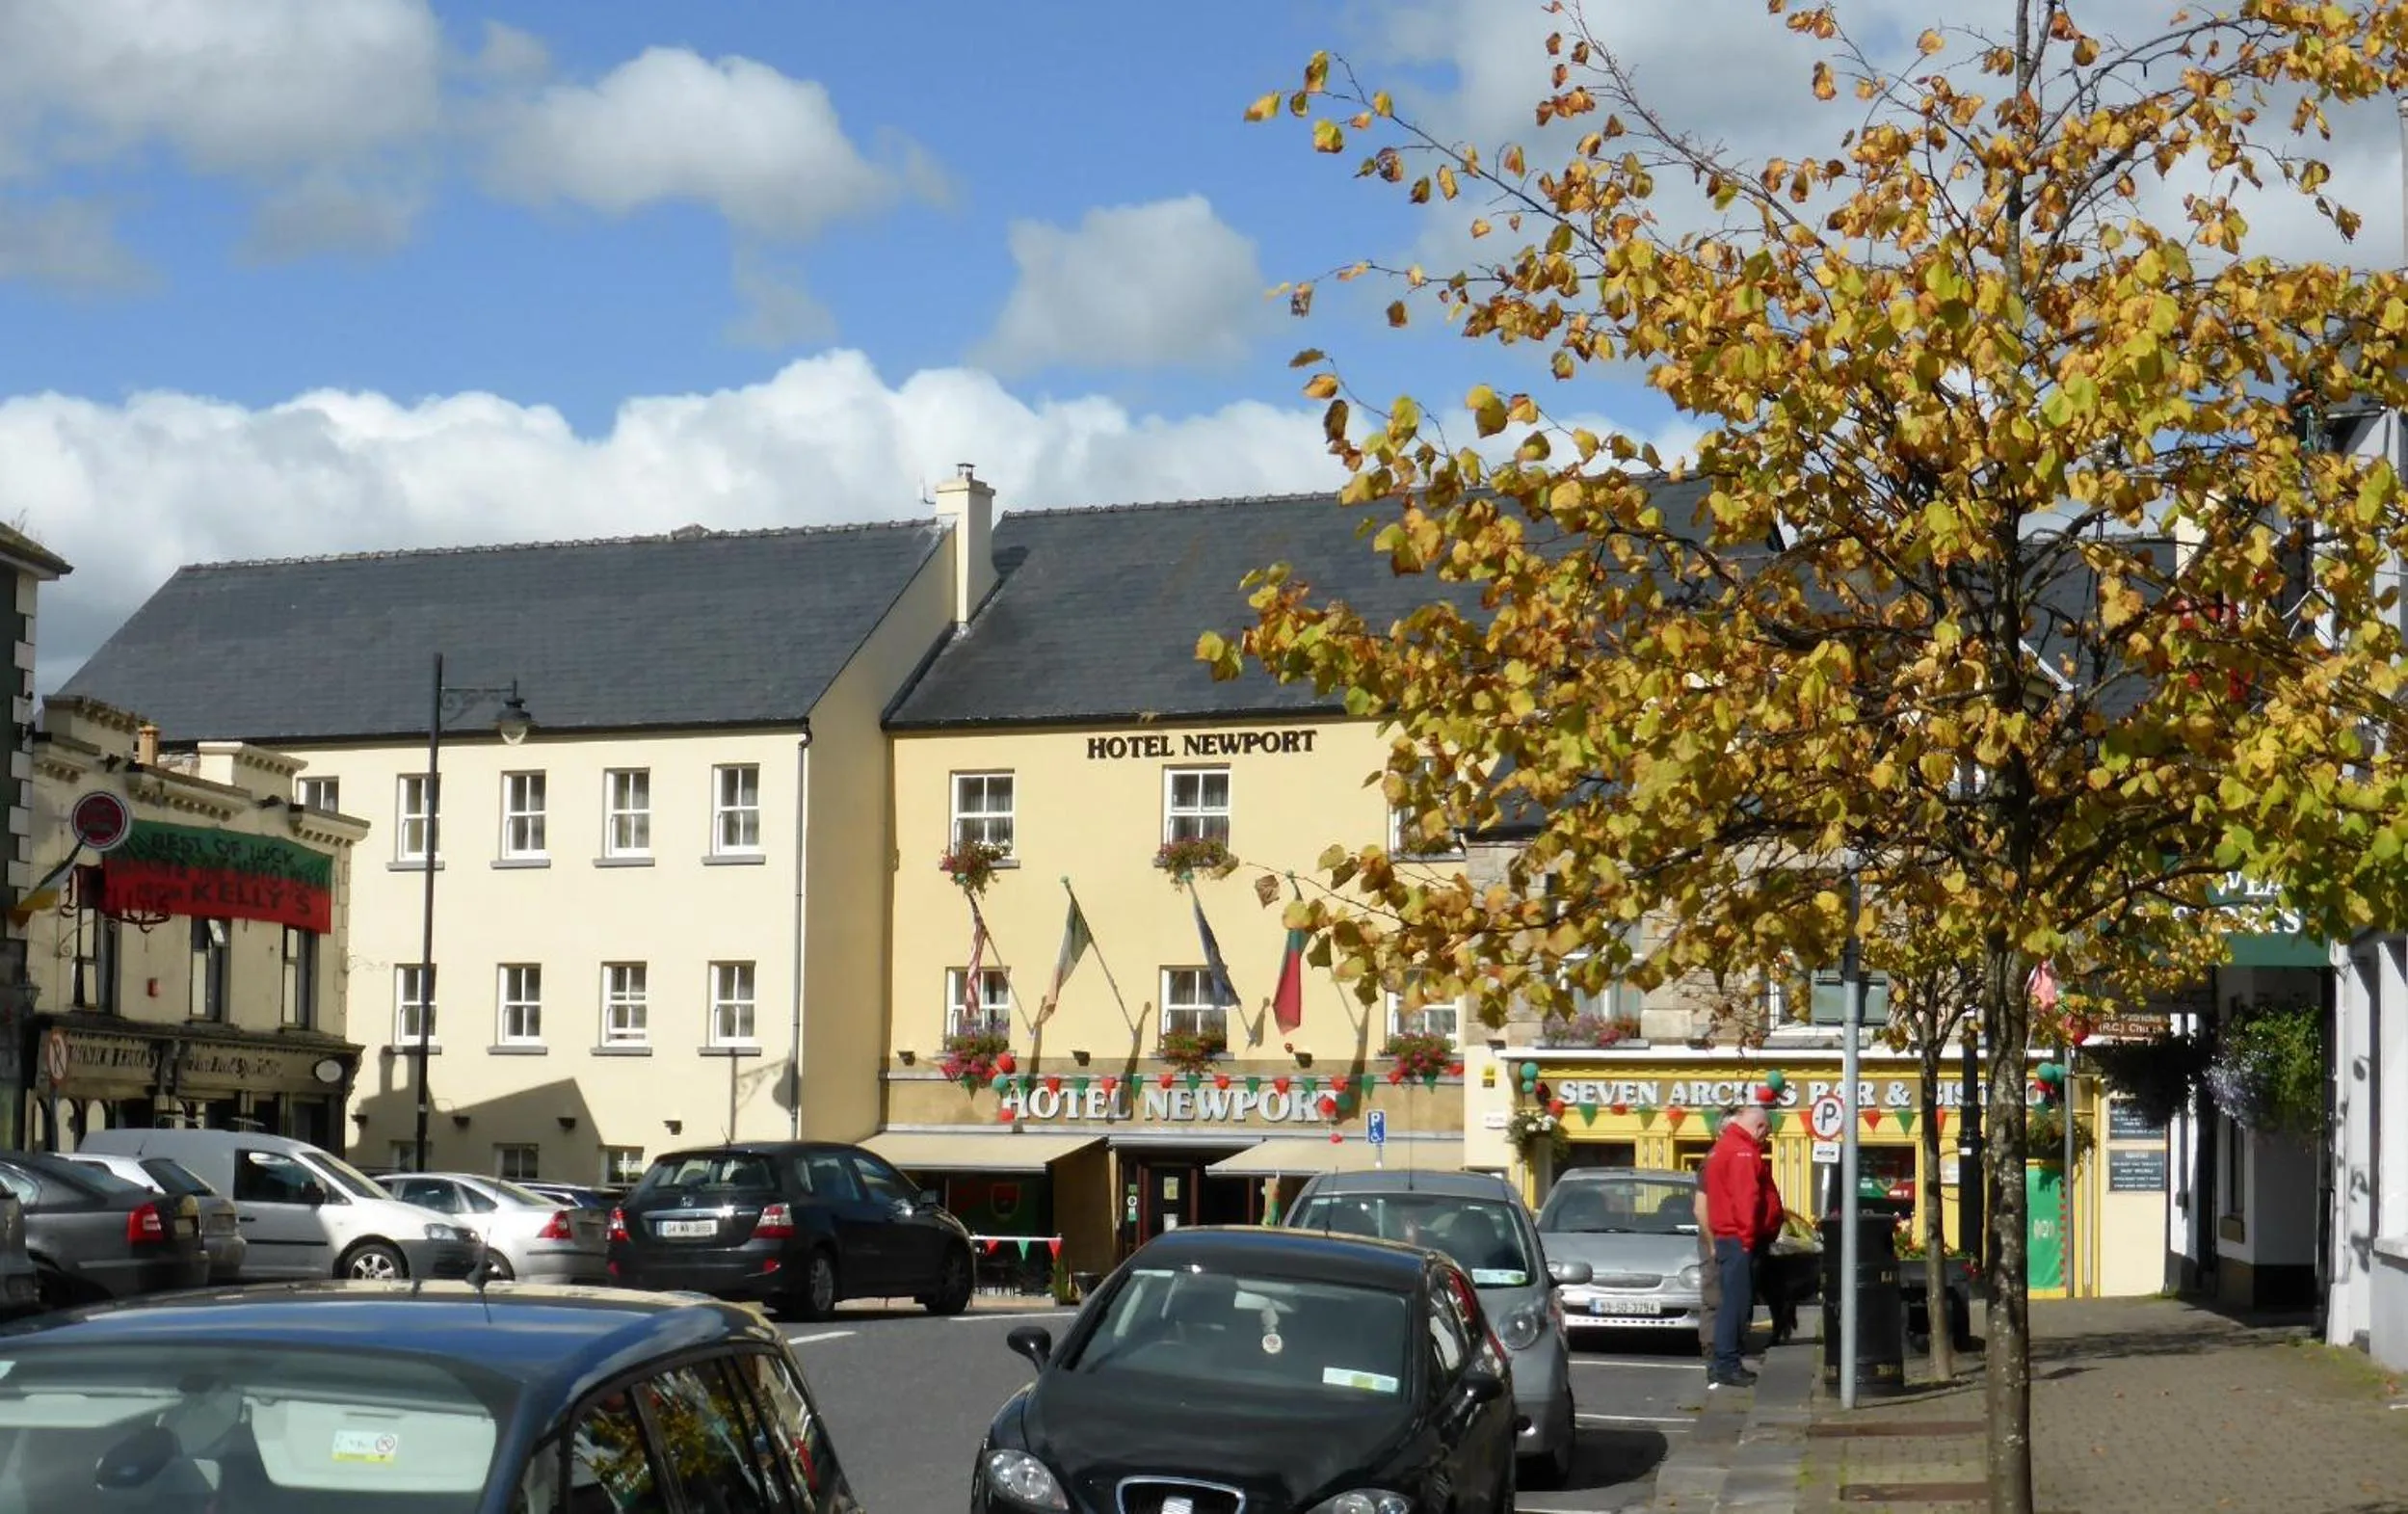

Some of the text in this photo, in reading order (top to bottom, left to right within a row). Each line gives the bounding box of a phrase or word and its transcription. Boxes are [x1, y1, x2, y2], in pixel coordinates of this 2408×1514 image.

[1087, 730, 1317, 758] HOTEL NEWPORT
[1001, 1085, 1132, 1121] HOTEL
[1558, 1079, 1658, 1105] SEVEN
[1883, 1080, 1912, 1106] &
[1370, 1112, 1381, 1128] P
[1821, 1102, 1838, 1131] P
